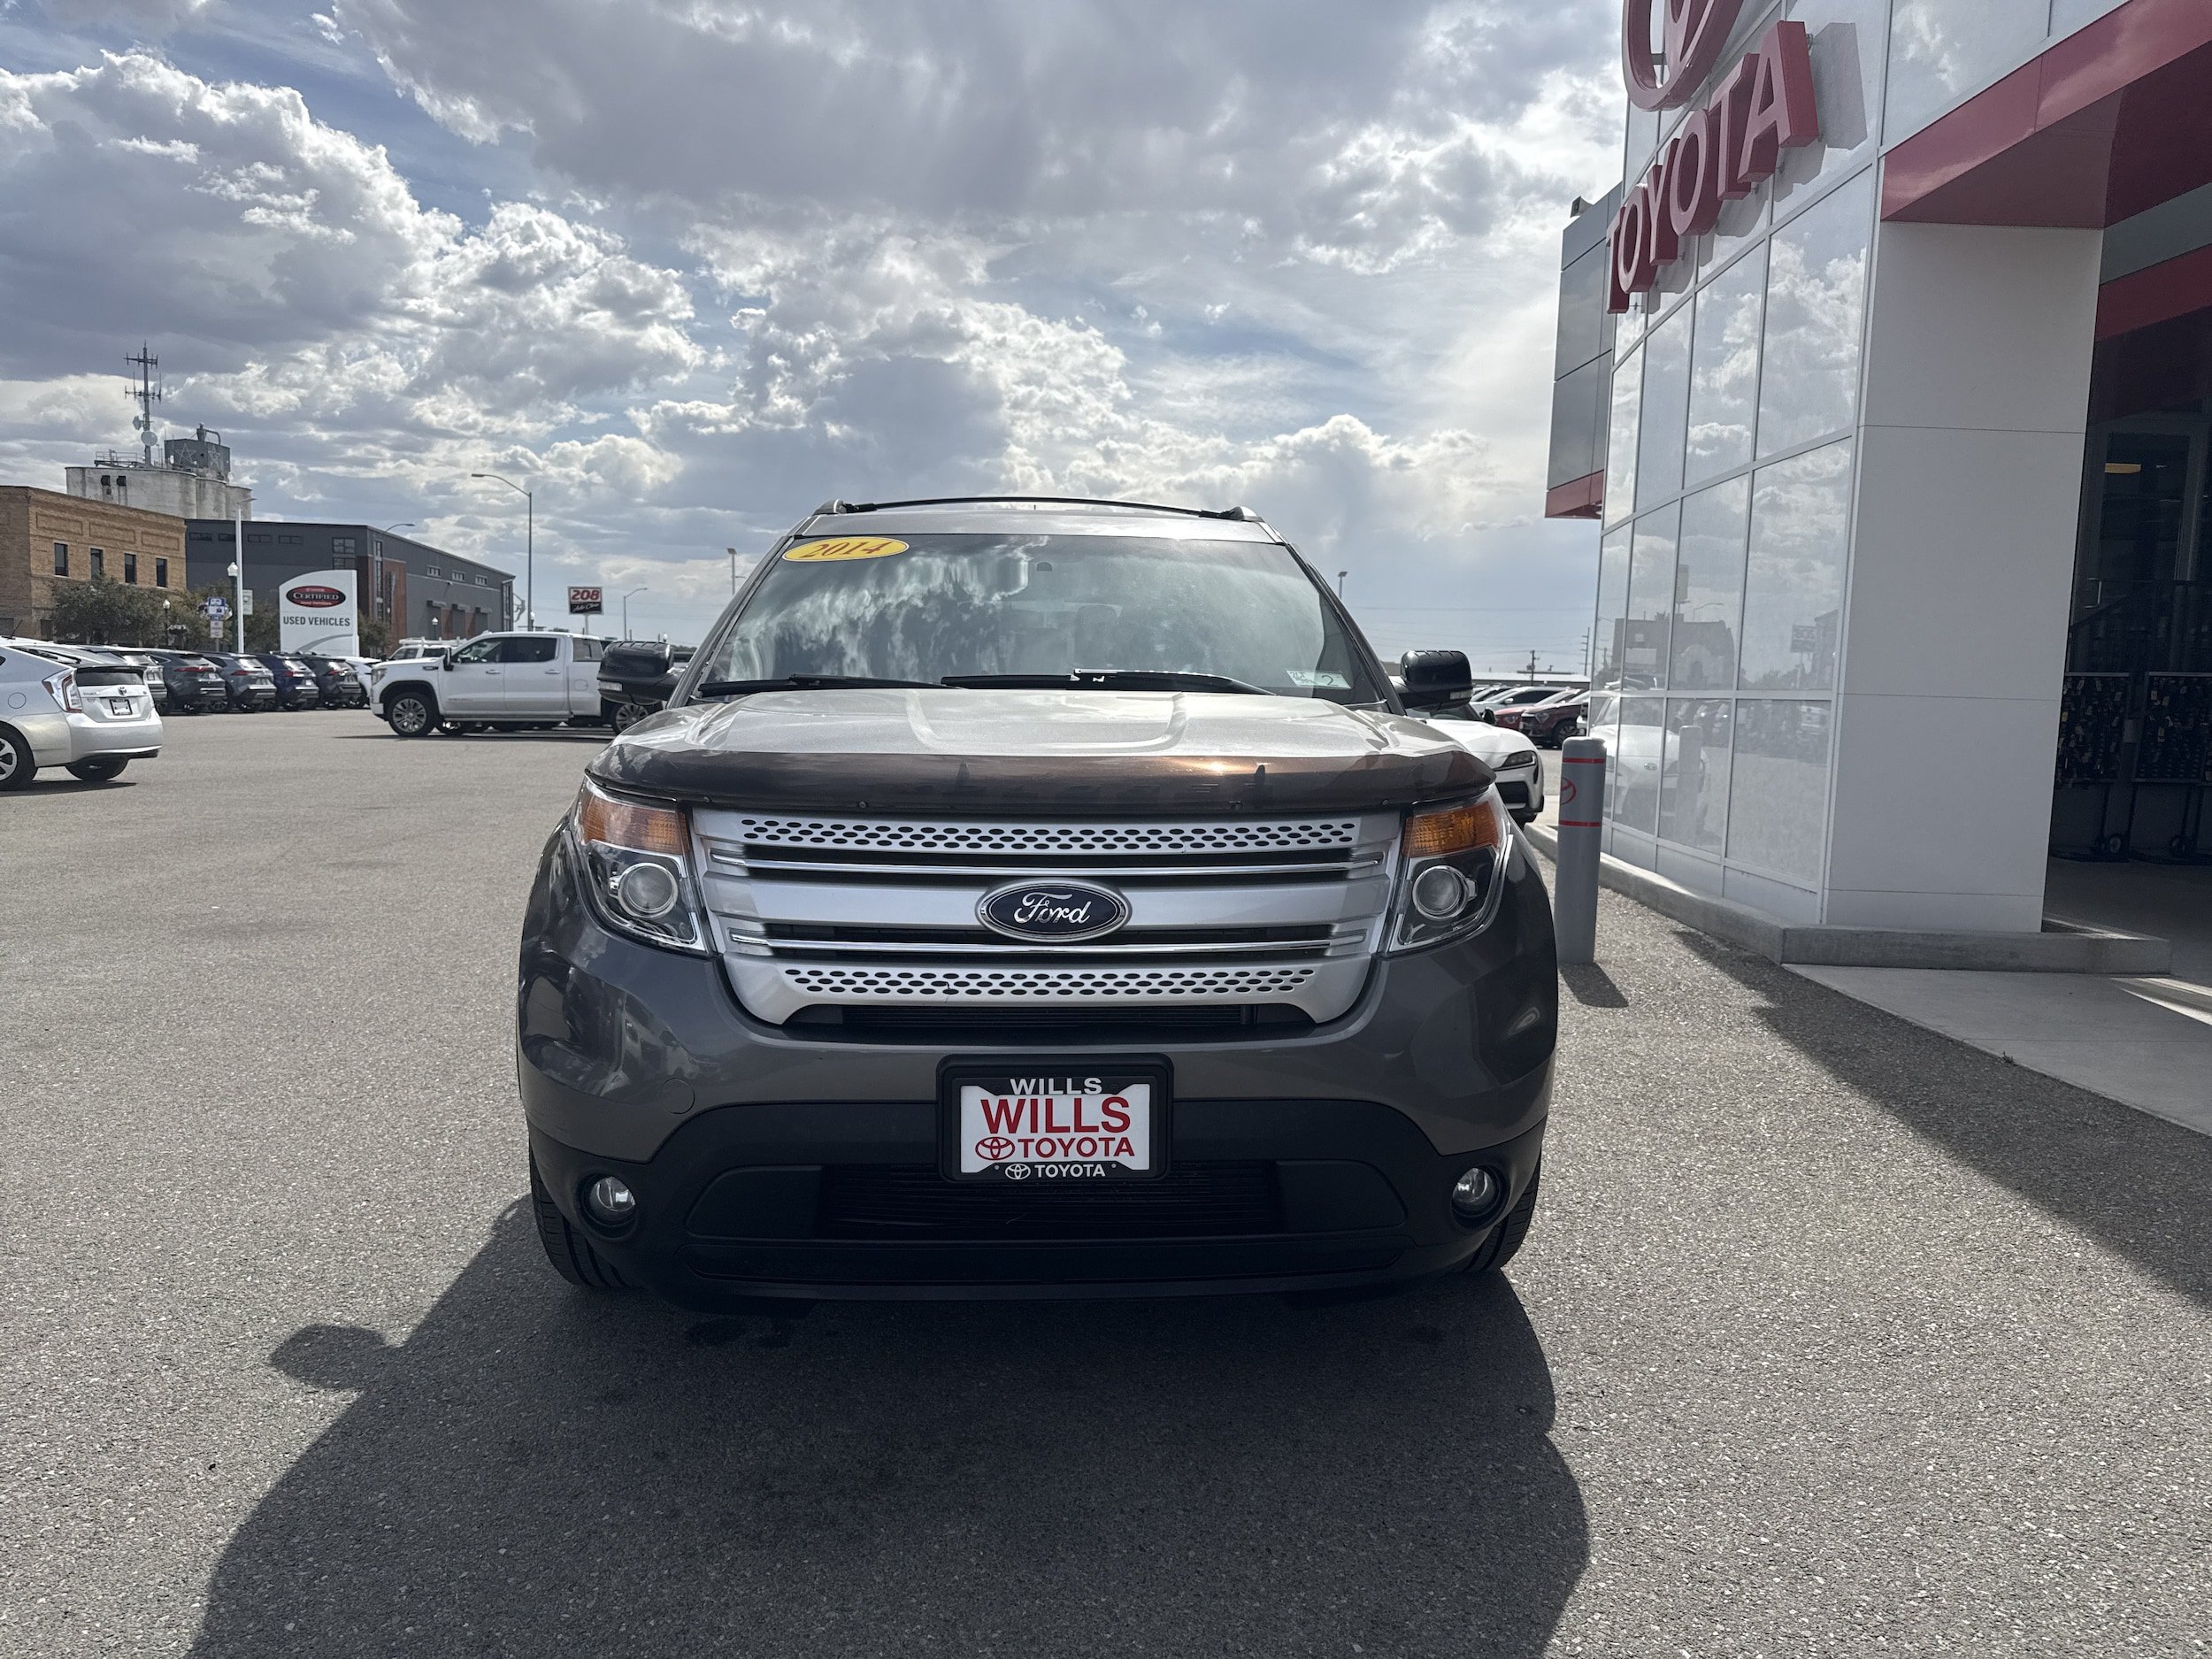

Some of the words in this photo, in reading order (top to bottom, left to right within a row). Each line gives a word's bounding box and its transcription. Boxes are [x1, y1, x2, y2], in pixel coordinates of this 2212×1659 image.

[1606, 19, 1820, 313] TOYOTA
[798, 541, 892, 559] 2014
[571, 589, 600, 601] 208
[283, 616, 306, 626] USED
[308, 617, 350, 626] VEHICLES
[1014, 892, 1092, 924] Ford
[1010, 1077, 1103, 1095] WILLS
[980, 1096, 1131, 1134] WILLS
[1018, 1136, 1135, 1158] TOYOTA
[1034, 1164, 1106, 1178] TOYOTA
